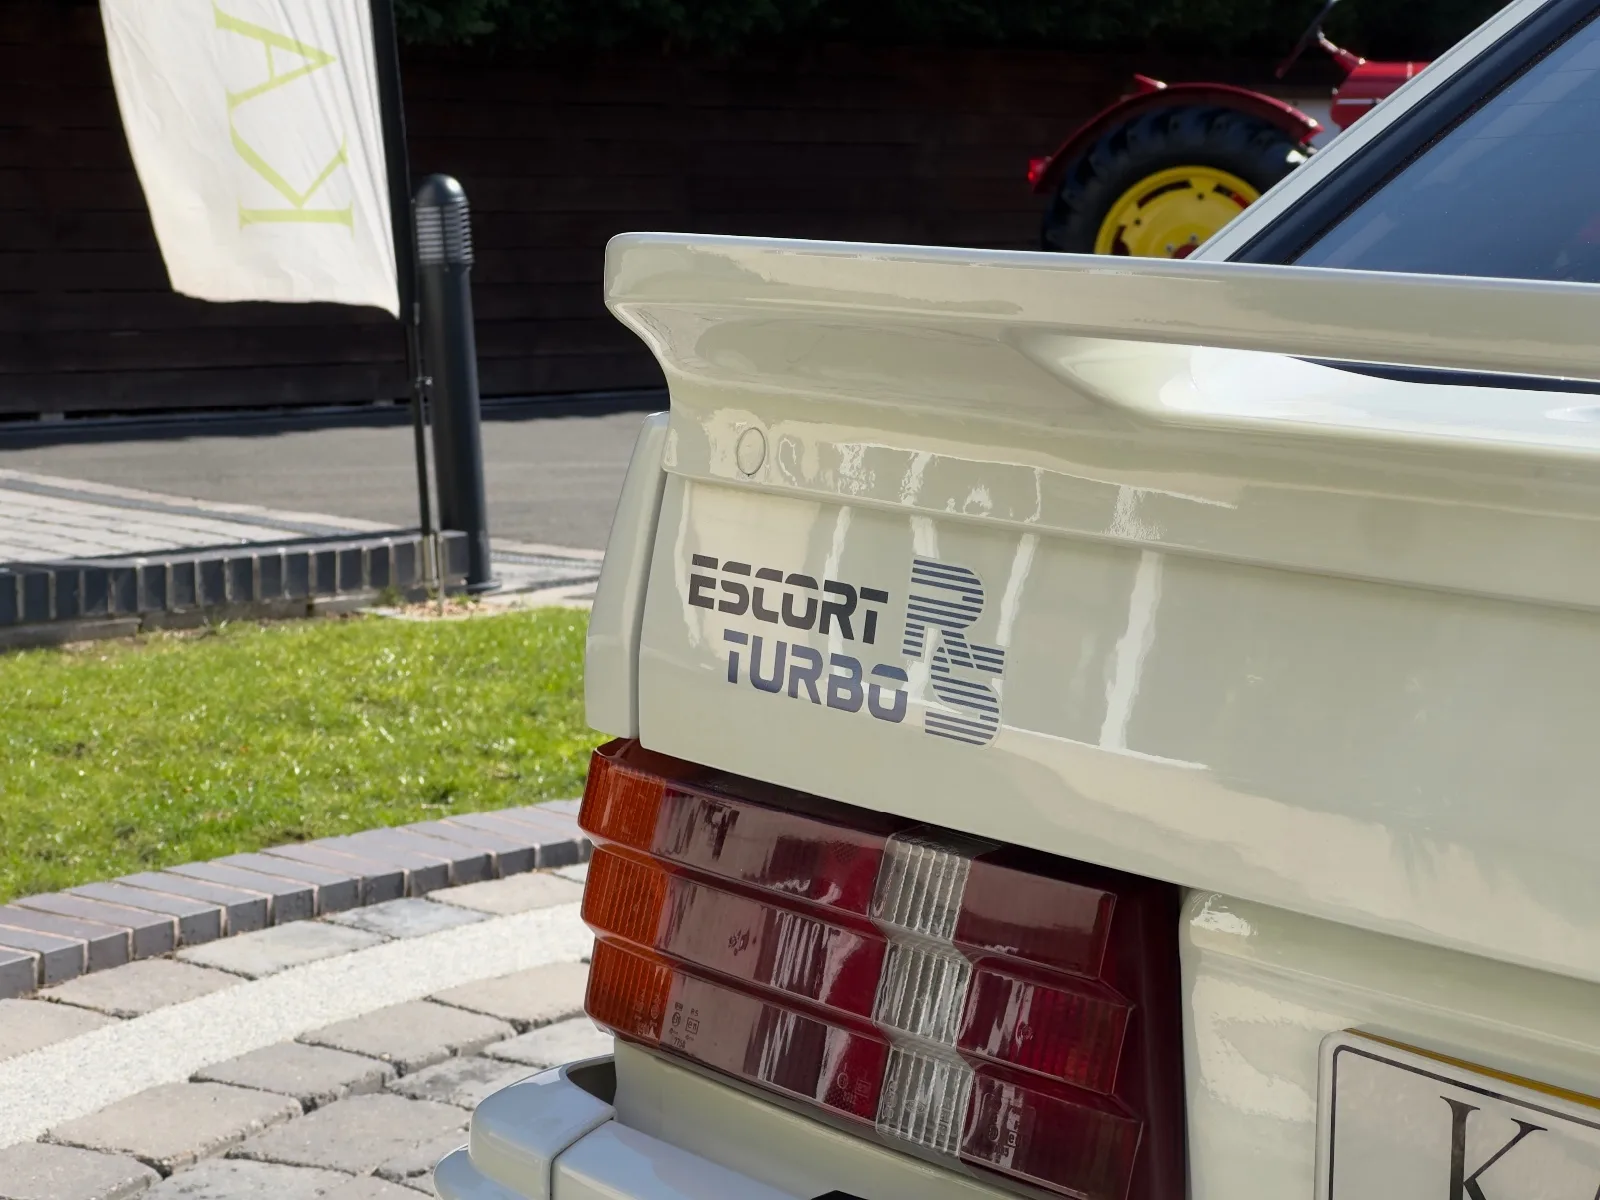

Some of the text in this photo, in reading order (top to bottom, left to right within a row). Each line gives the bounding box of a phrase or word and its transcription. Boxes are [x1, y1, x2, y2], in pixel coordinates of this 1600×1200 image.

[688, 554, 889, 645] ESCORT
[723, 629, 909, 724] TURBO
[902, 559, 1005, 746] RS
